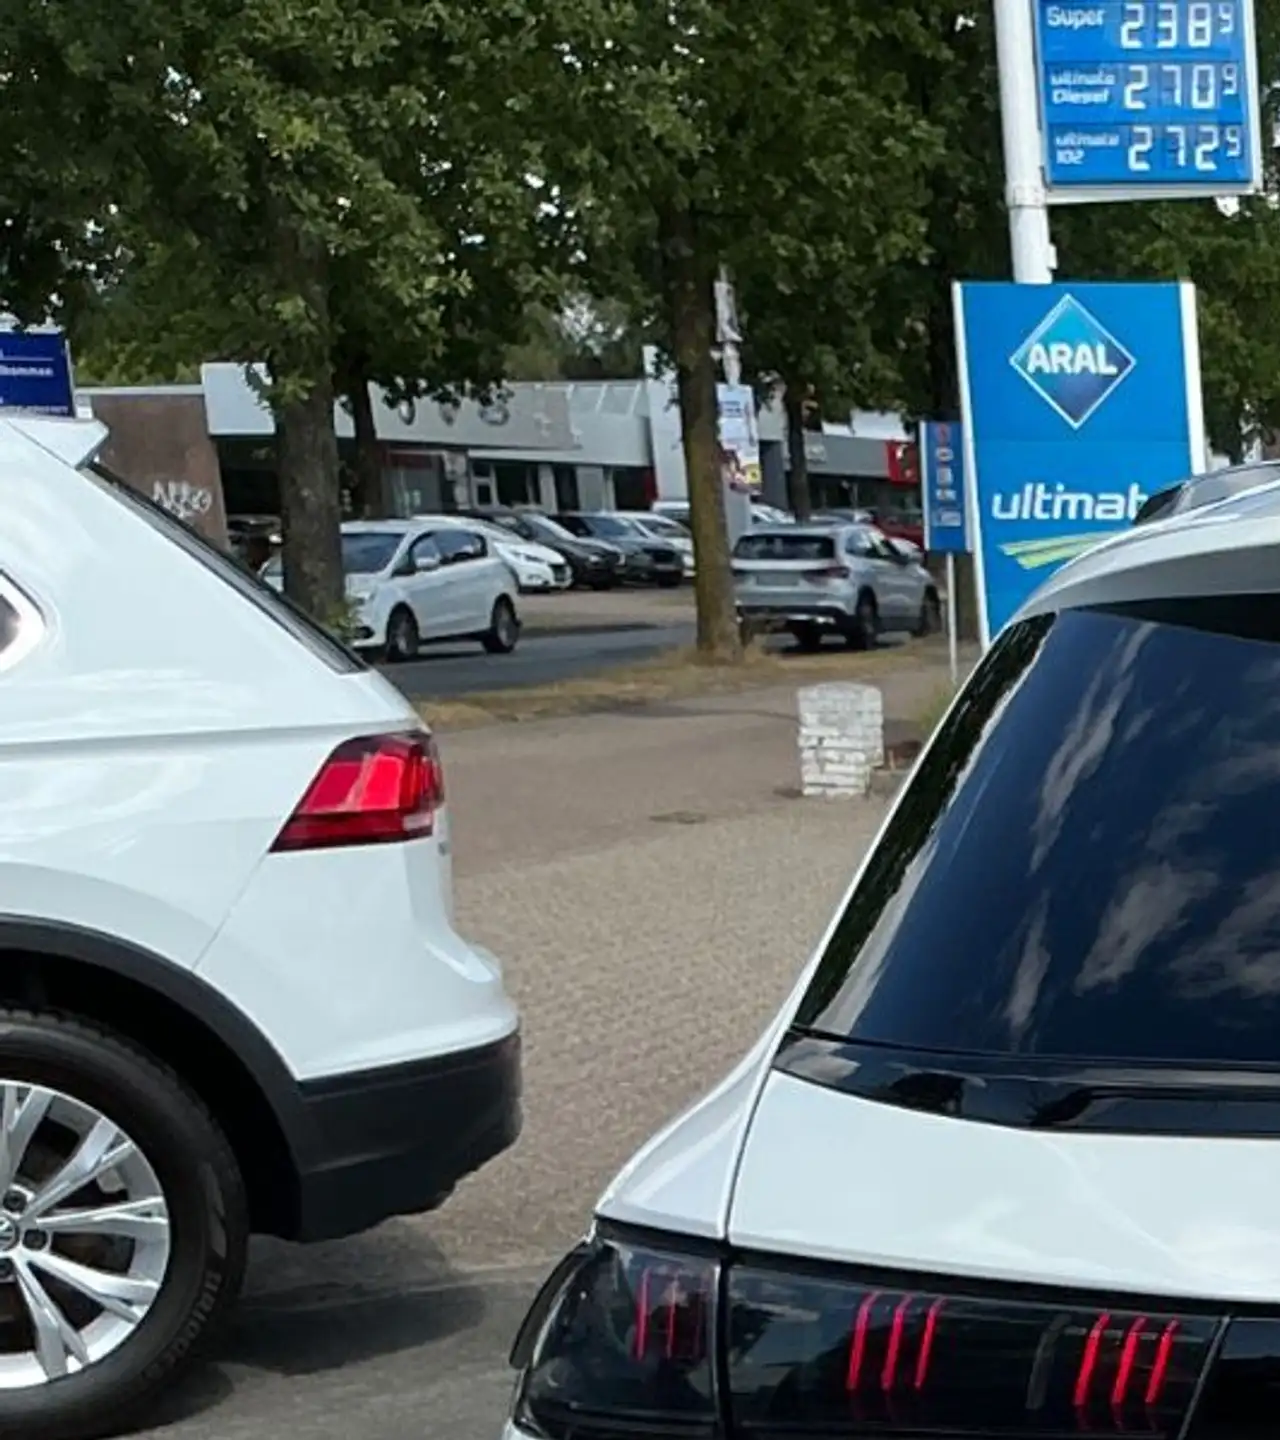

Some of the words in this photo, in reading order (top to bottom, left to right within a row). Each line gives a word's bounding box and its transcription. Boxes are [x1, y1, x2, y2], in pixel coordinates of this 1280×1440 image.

[1047, 6, 1105, 30] Super
[1027, 343, 1118, 375] ARAL
[991, 481, 1150, 520] ultimat
